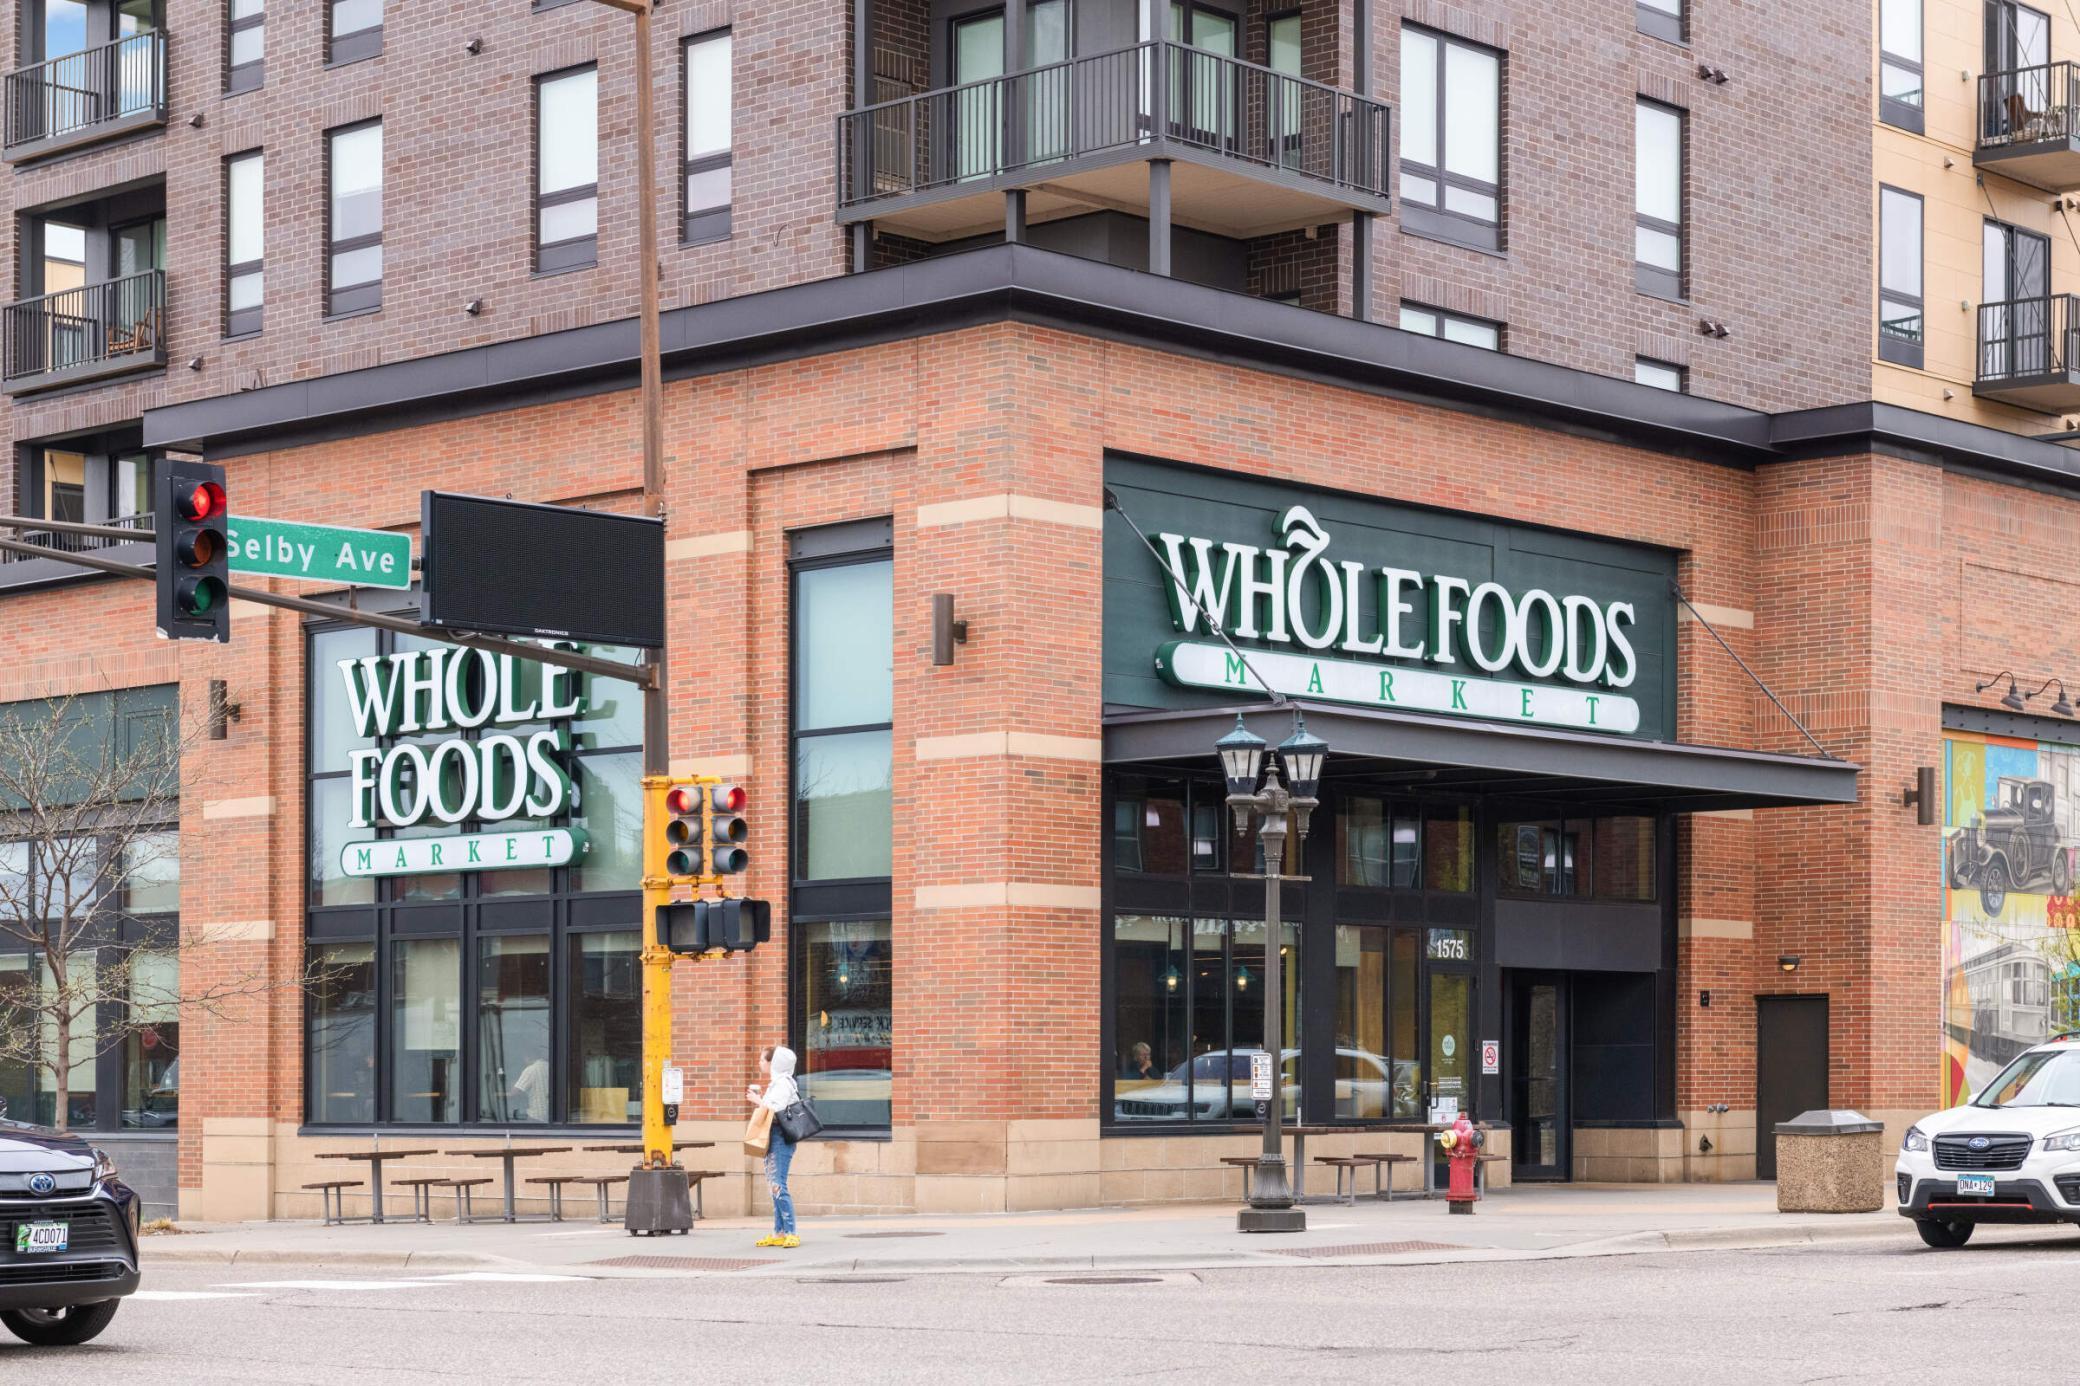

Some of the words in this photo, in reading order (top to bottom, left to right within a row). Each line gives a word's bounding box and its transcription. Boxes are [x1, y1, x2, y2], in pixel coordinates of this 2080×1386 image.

[228, 529, 315, 572] Selby
[336, 542, 395, 573] Ave
[1160, 506, 1425, 659] WHOLE
[1434, 574, 1637, 688] FOODS
[337, 640, 580, 737] WHOLE
[1224, 651, 1600, 725] MARKET
[348, 729, 561, 828] FOODS
[357, 835, 556, 871] MARKET
[1437, 938, 1464, 959] 1575
[33, 1227, 67, 1244] 4CD071
